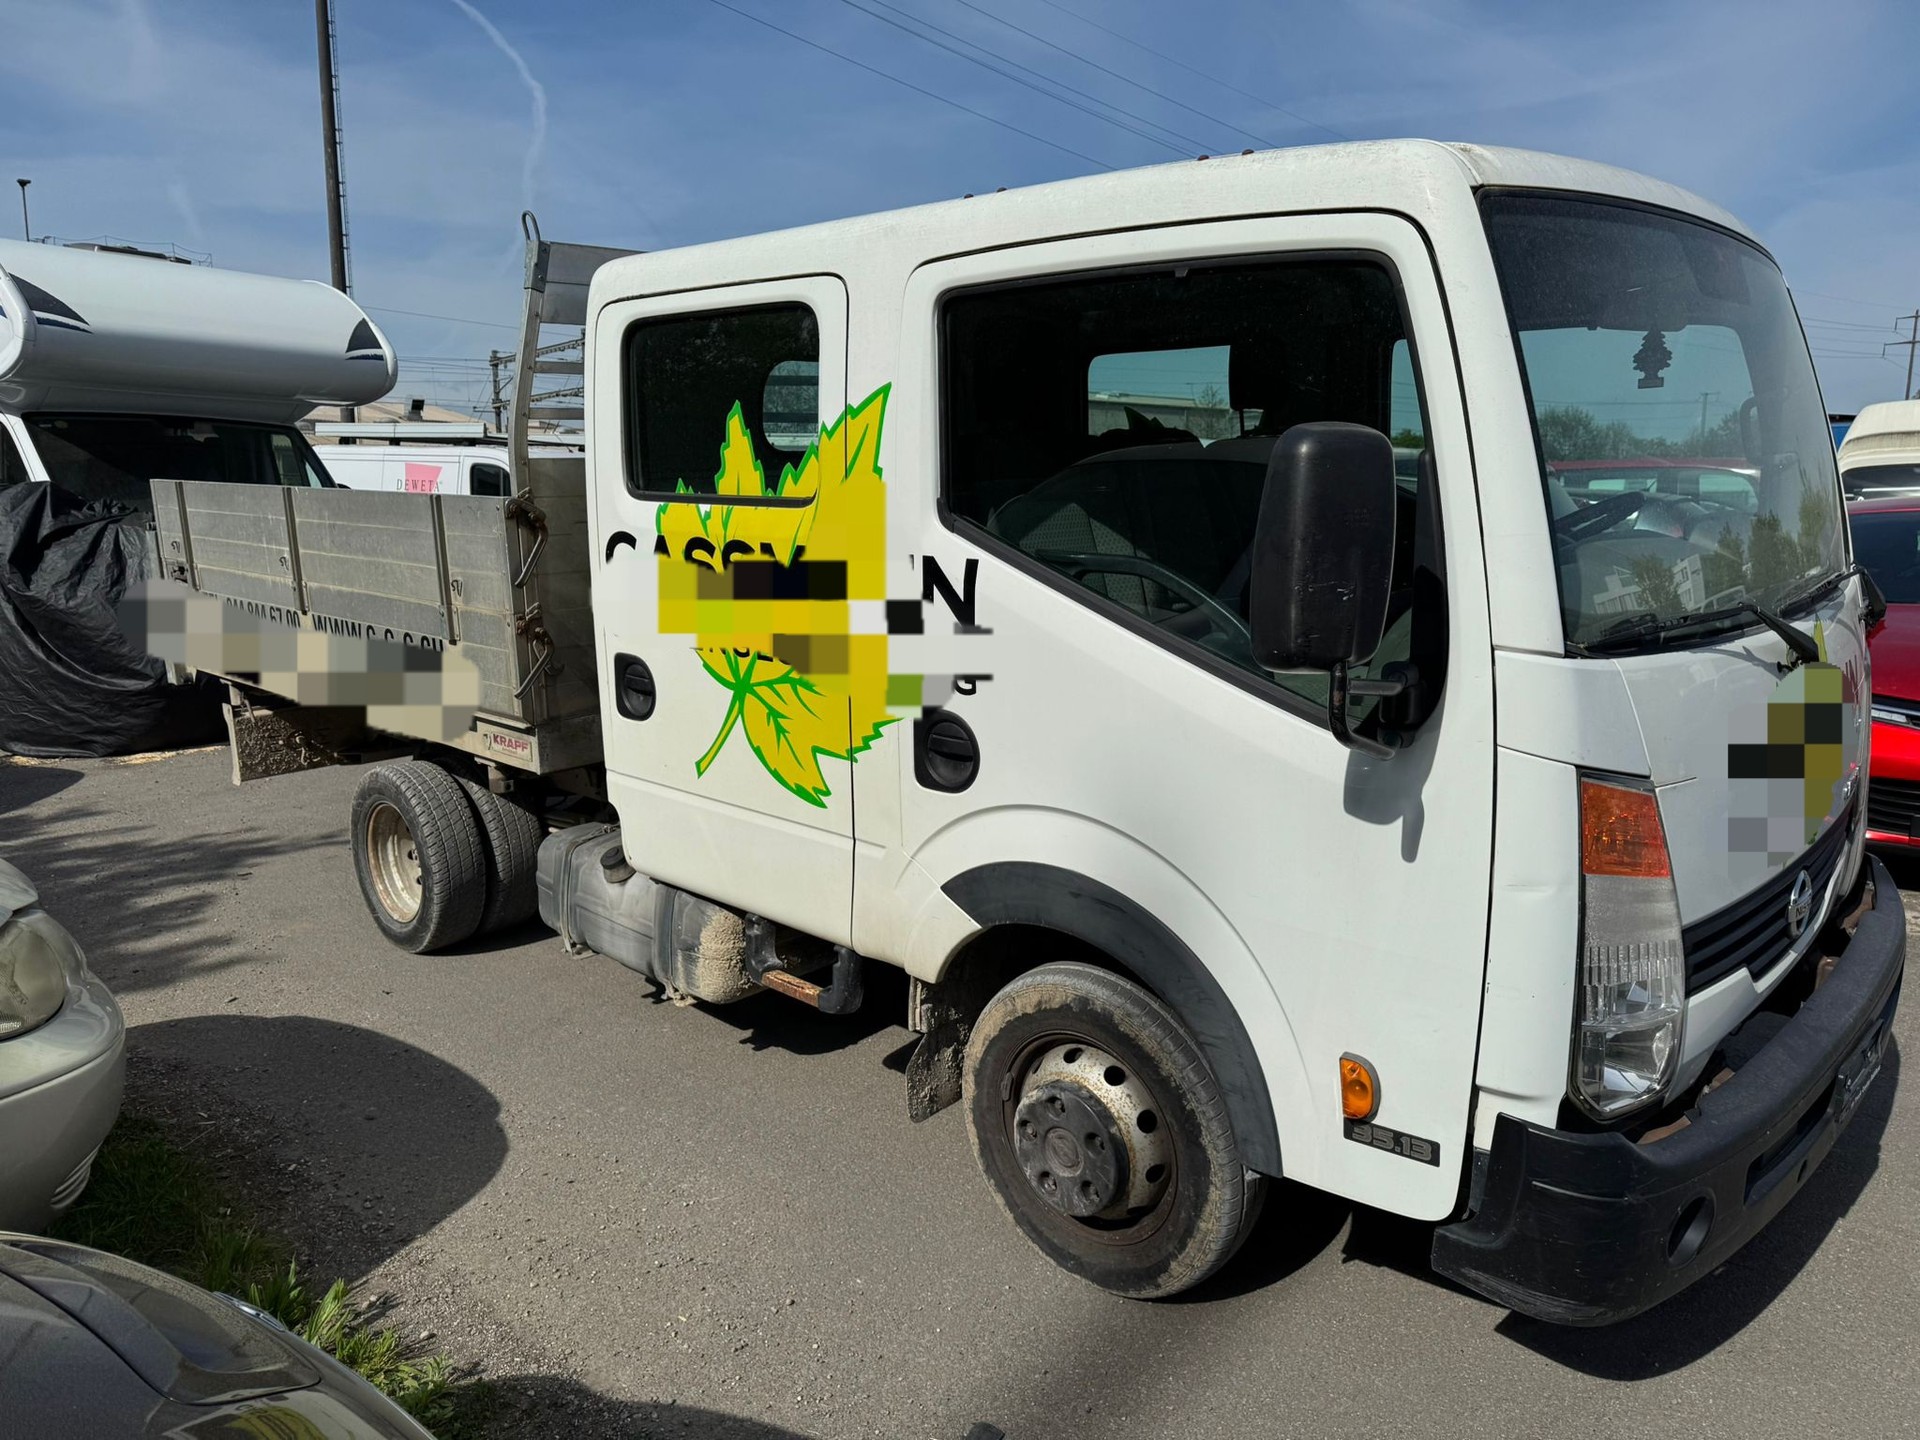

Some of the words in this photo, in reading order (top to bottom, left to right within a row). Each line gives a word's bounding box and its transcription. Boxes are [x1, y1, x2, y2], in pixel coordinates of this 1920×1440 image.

[396, 478, 440, 492] DEWETA
[492, 733, 529, 752] KRAPF
[1352, 1124, 1432, 1161] 35.13
